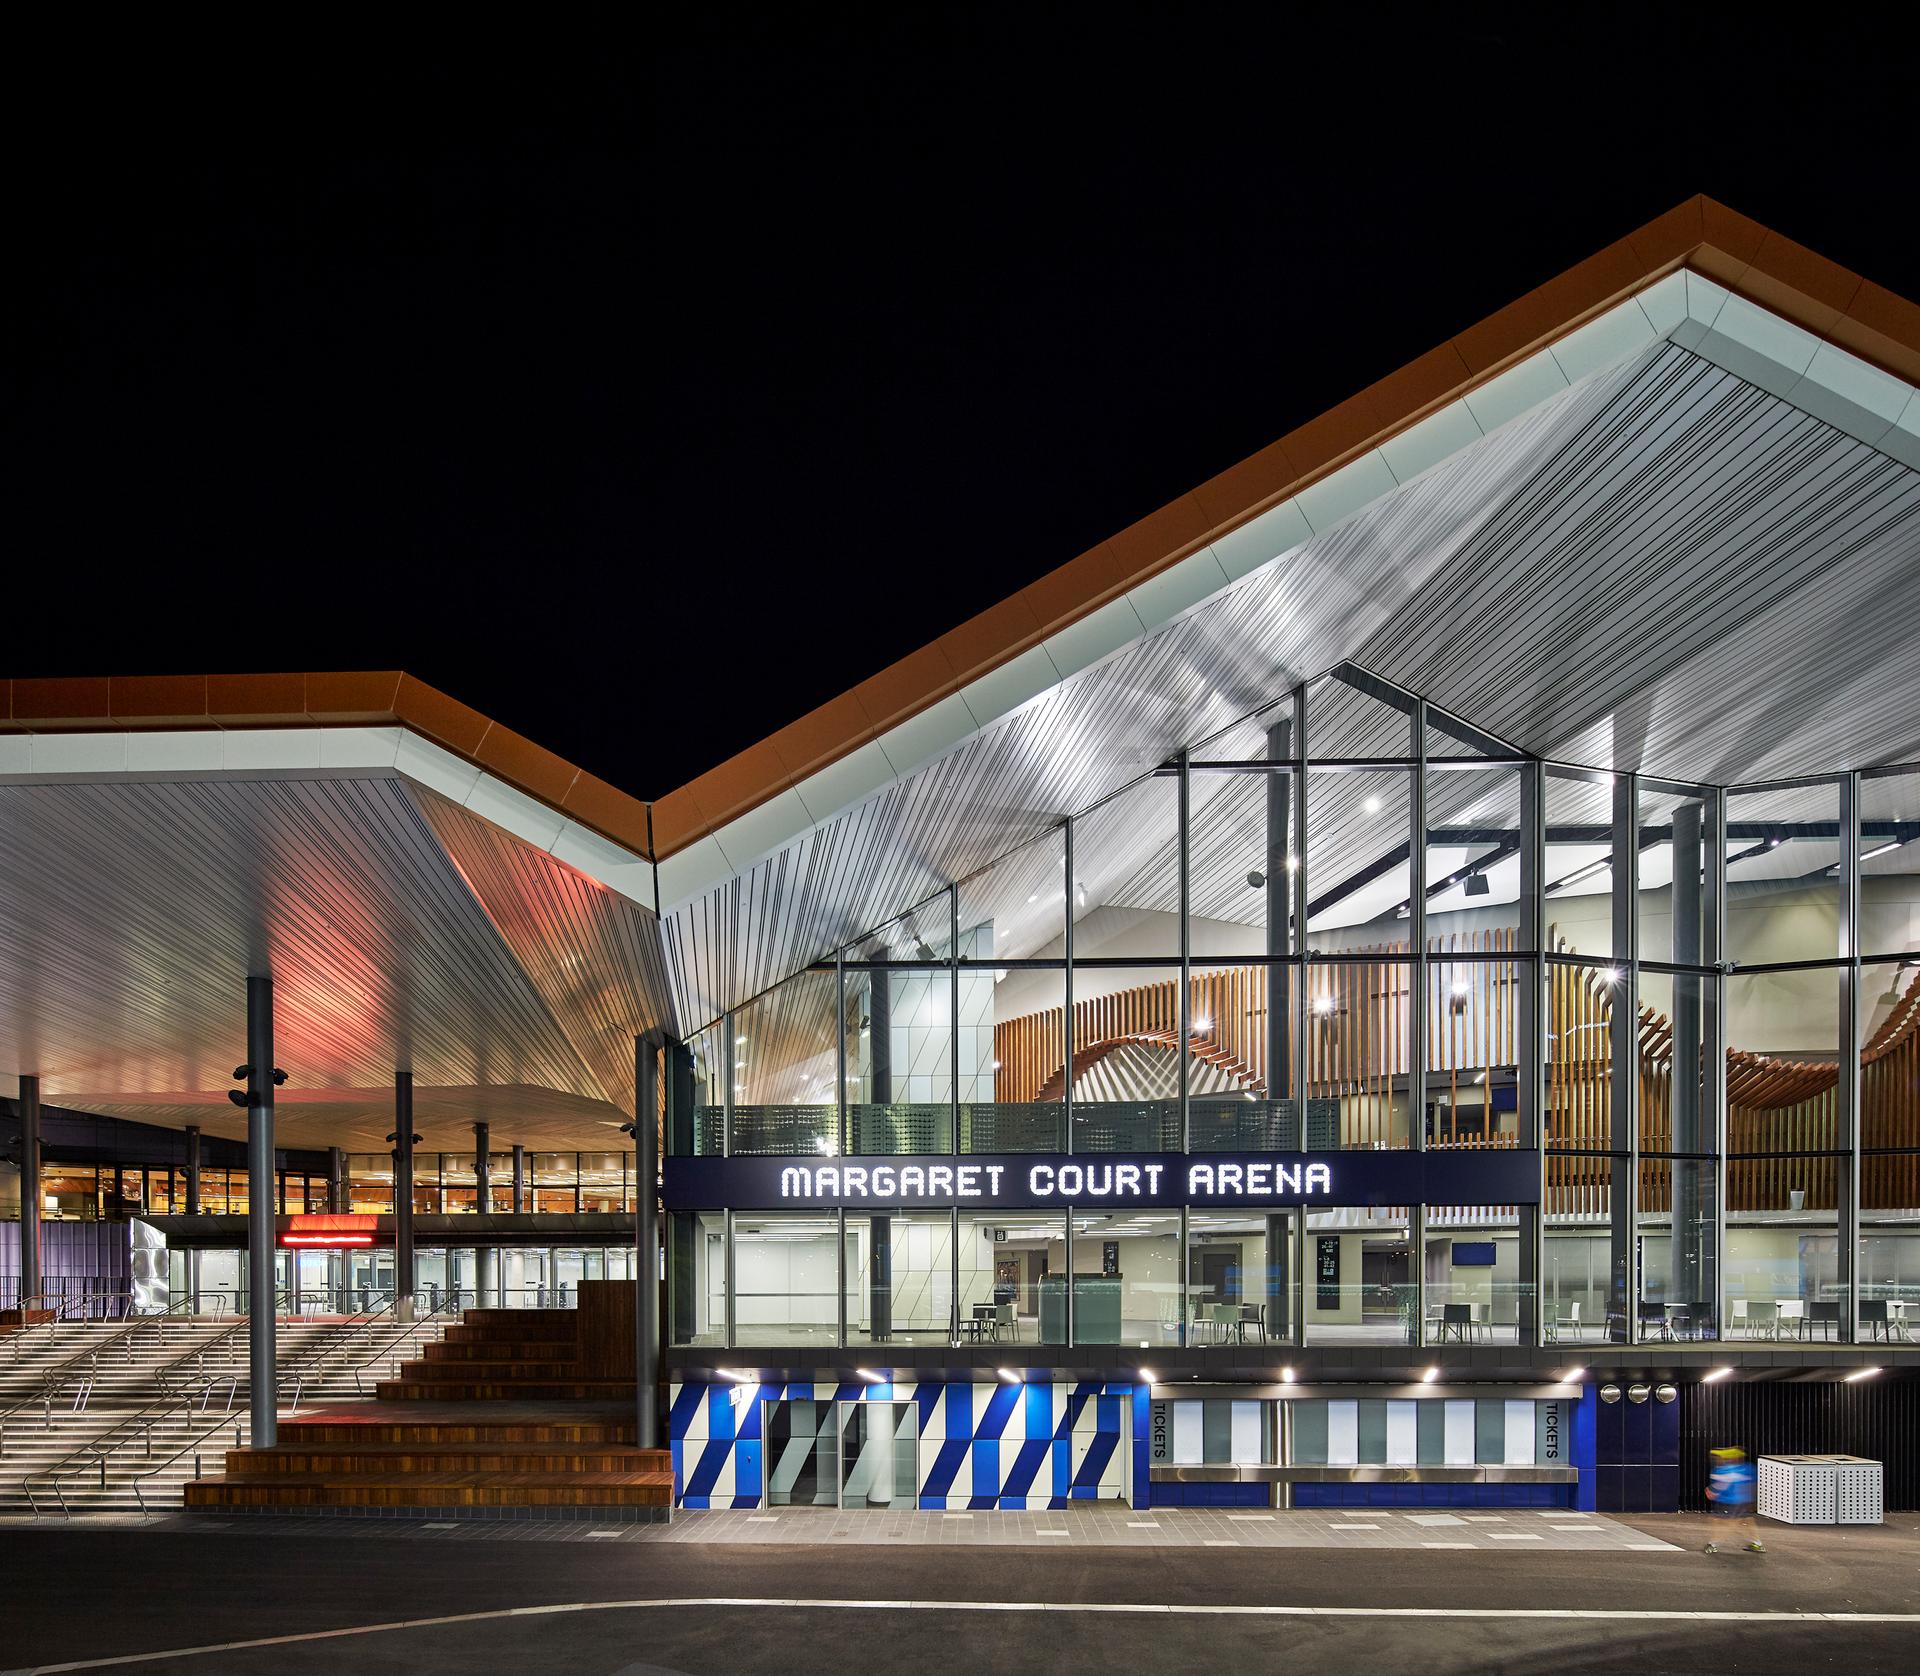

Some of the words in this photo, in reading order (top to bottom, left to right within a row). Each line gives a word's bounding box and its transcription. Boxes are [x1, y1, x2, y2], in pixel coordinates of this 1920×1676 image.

[781, 1166, 1004, 1197] MARGARET
[1029, 1165, 1163, 1195] COURT
[1188, 1163, 1331, 1195] ARENA
[1154, 1404, 1166, 1458] TICKETS
[1546, 1403, 1558, 1458] TICKETS
